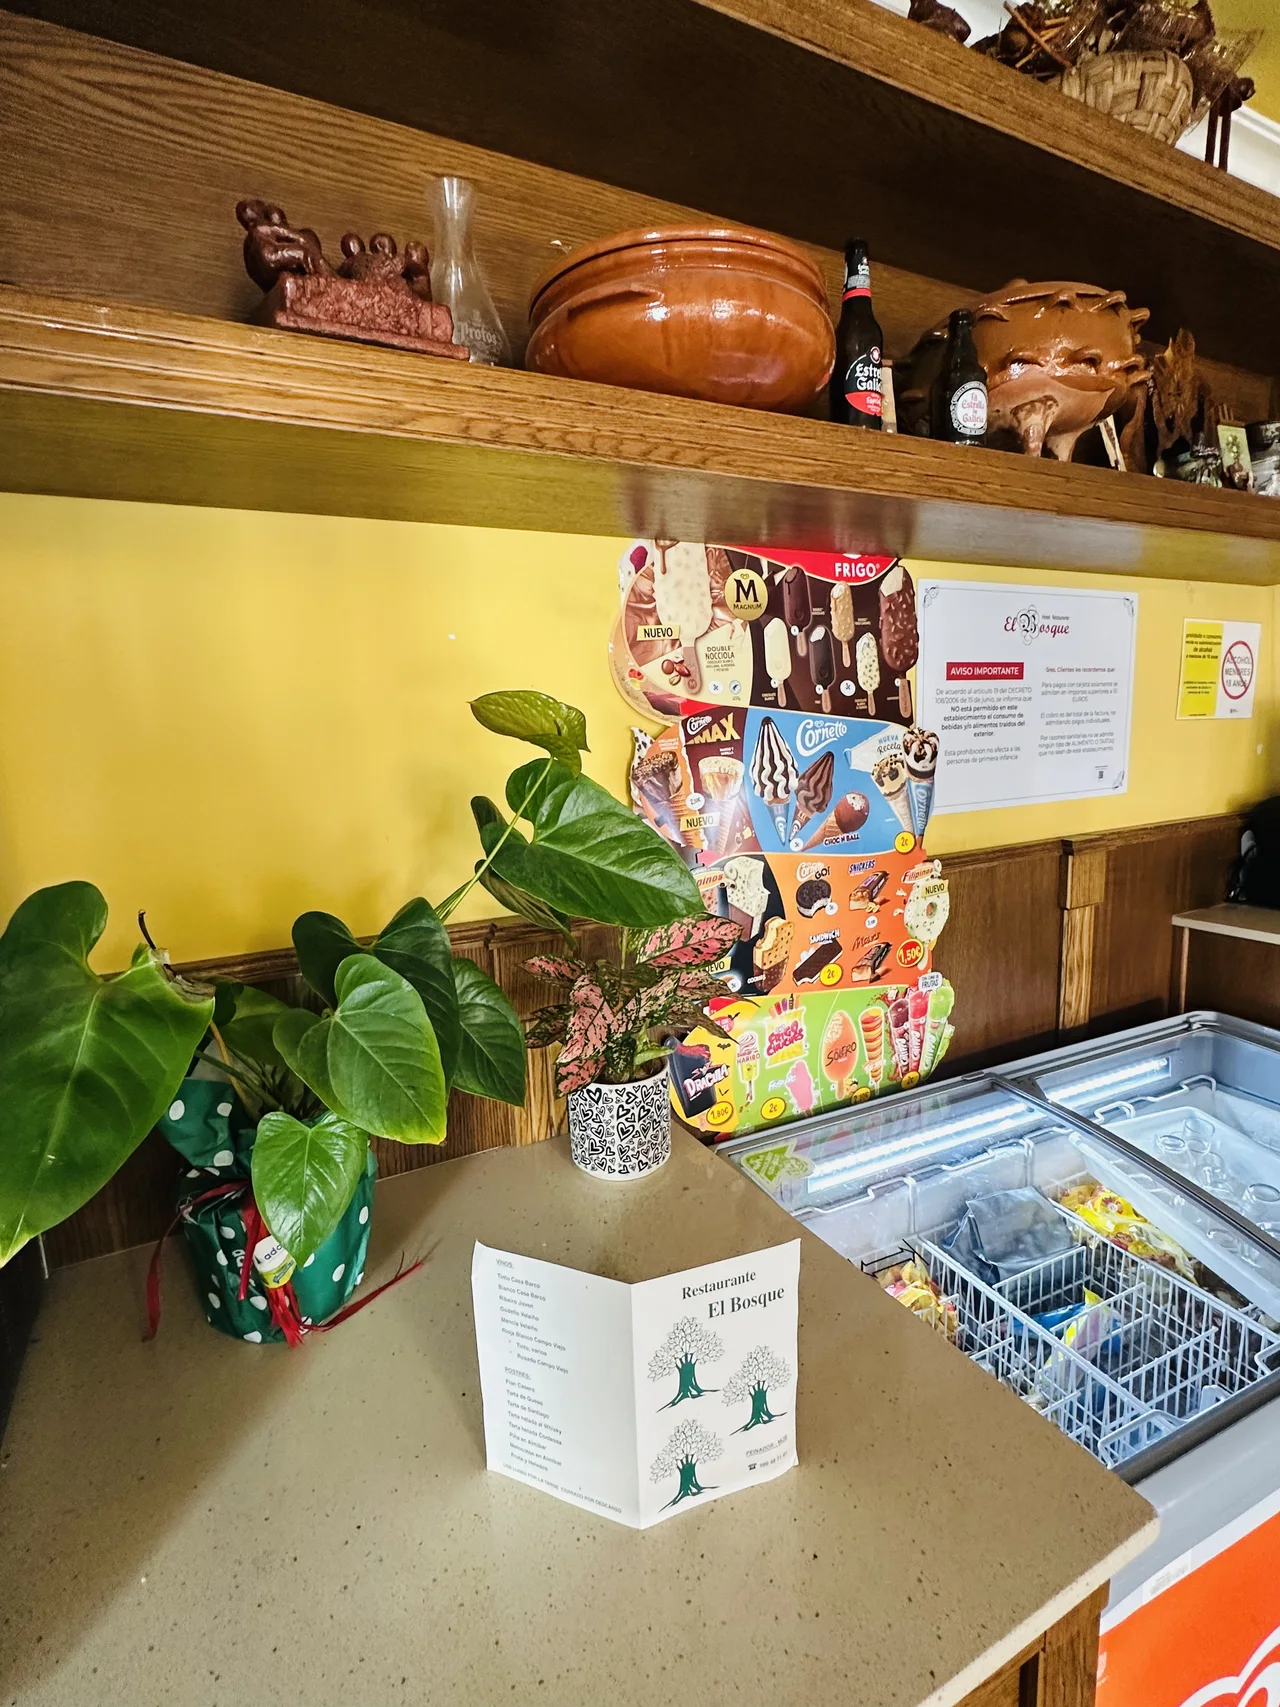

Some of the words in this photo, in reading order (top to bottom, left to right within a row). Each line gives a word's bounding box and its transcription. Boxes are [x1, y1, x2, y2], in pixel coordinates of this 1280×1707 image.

[461, 320, 497, 345] Protos
[854, 363, 881, 377] Estre
[834, 562, 876, 577] FRIGO
[1004, 616, 1017, 632] El
[1019, 612, 1069, 637] Bosque
[644, 627, 673, 639] NUEVO
[705, 651, 735, 660] NOCCIOLA
[950, 667, 973, 675] AVISO
[974, 667, 1019, 675] IMPORTANTE
[690, 712, 741, 744] MAX
[941, 723, 963, 731] bebidas
[796, 719, 847, 756] Cornetto
[878, 735, 899, 744] NUEVA
[877, 744, 901, 755] Receta
[947, 757, 970, 765] personas
[979, 755, 999, 763] primera
[686, 815, 714, 828] NUEVO
[824, 837, 840, 846] CHOC
[846, 834, 860, 843] BALL
[849, 860, 876, 873] SNICKERS
[903, 867, 933, 882] Filipinos
[925, 885, 945, 895] NUEVO
[810, 929, 840, 943] SANDWICH
[852, 932, 881, 951] Mars
[899, 945, 921, 964] 1,50€
[922, 980, 939, 989] FRUTAS
[768, 1020, 800, 1043] FRIGO
[767, 1028, 804, 1056] CHUCHES
[911, 1030, 920, 1060] Calippo
[737, 1053, 760, 1064] HARIBO
[825, 1042, 857, 1067] SOLERO
[896, 1038, 909, 1065] Calippo
[683, 1065, 729, 1096] DRACULA
[497, 1273, 510, 1281] Tinto
[511, 1277, 524, 1285] Casa
[525, 1280, 541, 1289] Barco
[682, 1270, 757, 1300] Restaurante
[498, 1284, 516, 1293] Blanco
[516, 1289, 530, 1297] Casa
[530, 1292, 546, 1302] Barco
[499, 1295, 518, 1304] Ribeiro
[518, 1300, 534, 1309] Joven
[708, 1302, 725, 1319] El
[730, 1287, 785, 1314] Bosque
[500, 1306, 520, 1316] Godello
[502, 1328, 515, 1336] Rioja
[516, 1331, 533, 1341] Blanco
[534, 1336, 552, 1347] Campo
[553, 1342, 566, 1351] Viejo
[531, 1348, 547, 1356] varios
[517, 1353, 536, 1363] Rosado
[537, 1359, 555, 1370] Campo
[556, 1365, 569, 1374] Viejo
[517, 1383, 535, 1393] Casero
[506, 1389, 519, 1398] Tarta
[527, 1396, 544, 1406] Queso
[507, 1400, 520, 1408] Tarta
[527, 1407, 550, 1419] Santiago
[508, 1410, 520, 1419] Tarta
[521, 1416, 537, 1426] helada
[544, 1423, 562, 1436] Whisky
[508, 1421, 520, 1430] Tarta
[521, 1426, 538, 1436] helada
[561, 1487, 584, 1500] CERRADO
[584, 1495, 595, 1503] POR
[595, 1499, 622, 1514] DESCANSO
